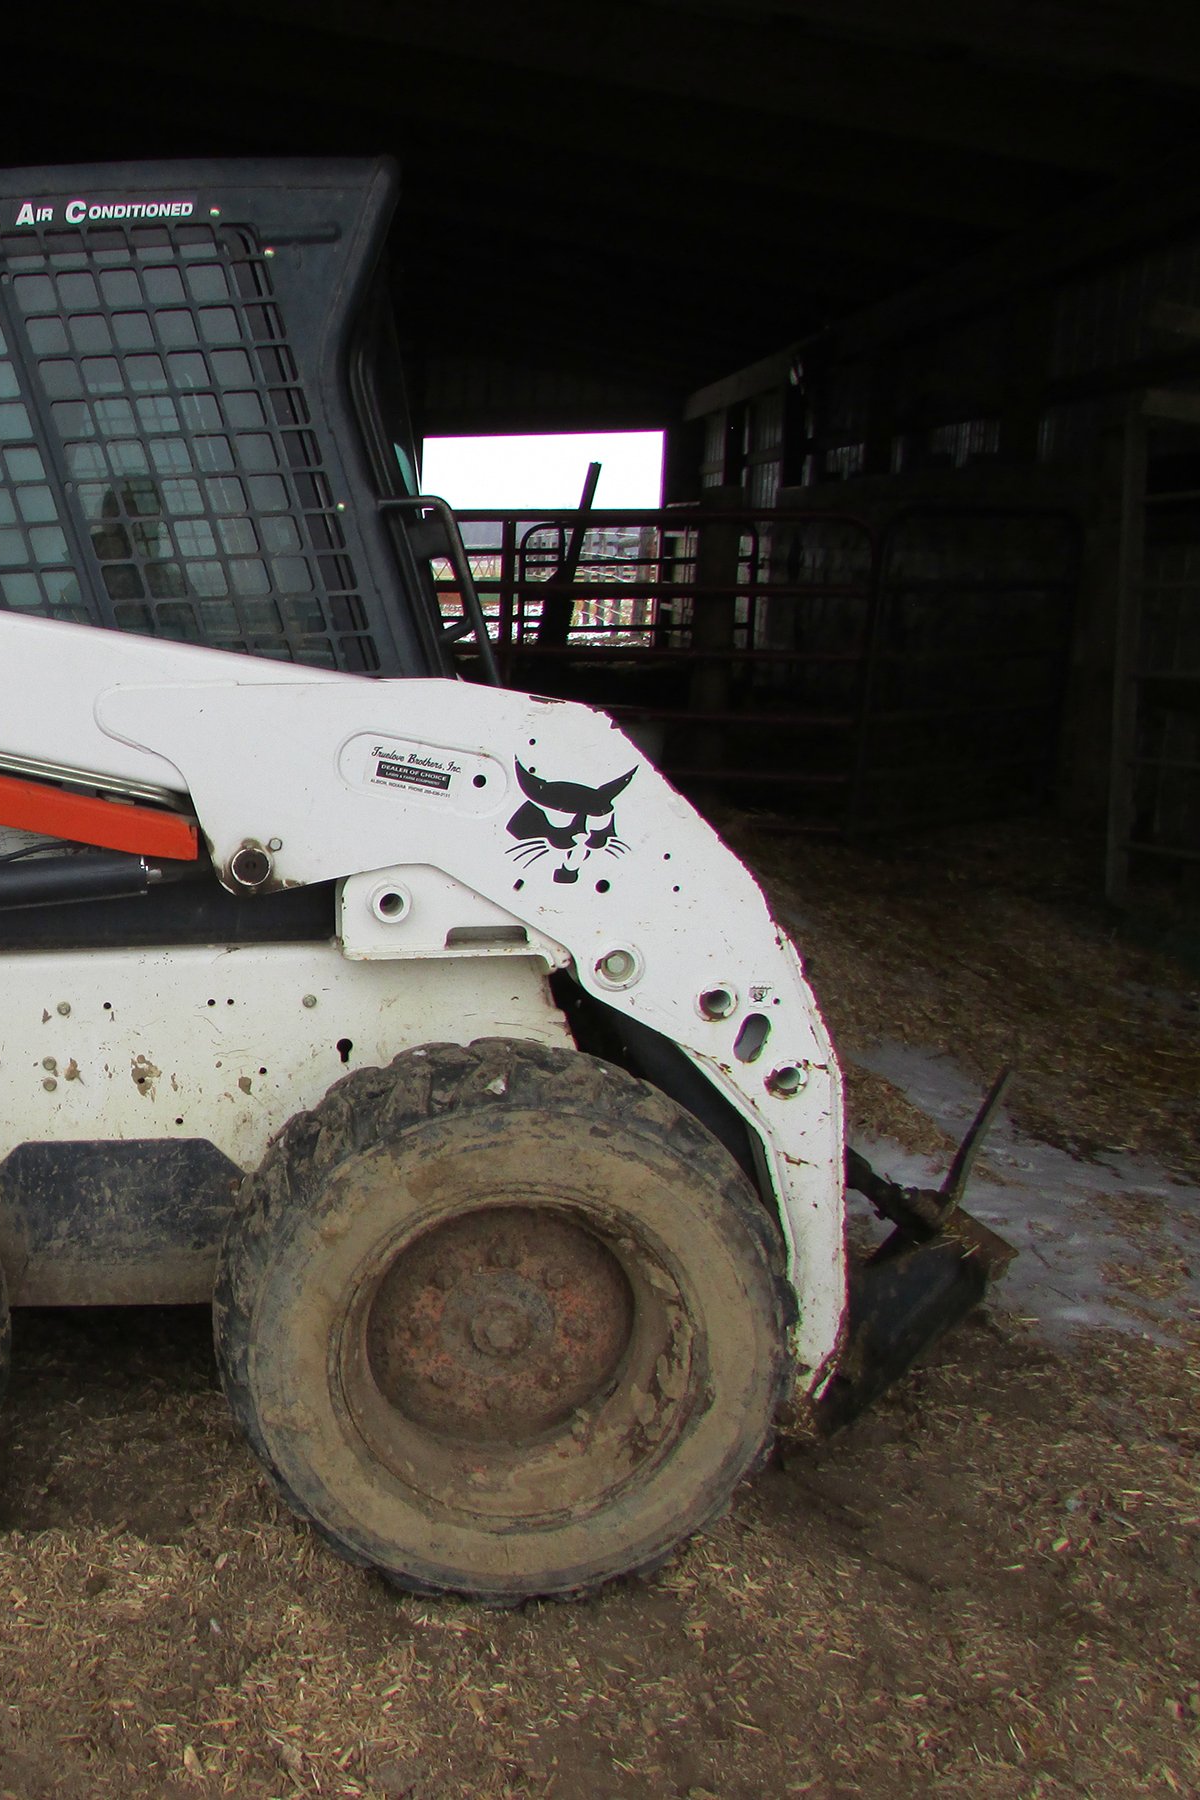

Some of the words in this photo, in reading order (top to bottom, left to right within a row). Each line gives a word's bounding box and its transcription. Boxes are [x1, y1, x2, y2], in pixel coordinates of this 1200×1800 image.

[17, 203, 53, 225] AIR
[65, 201, 193, 224] CONDITIONED
[371, 746, 405, 761] Truelove
[447, 761, 462, 773] Inc.
[381, 764, 408, 774] DEALER
[420, 771, 447, 782] CHOICE
